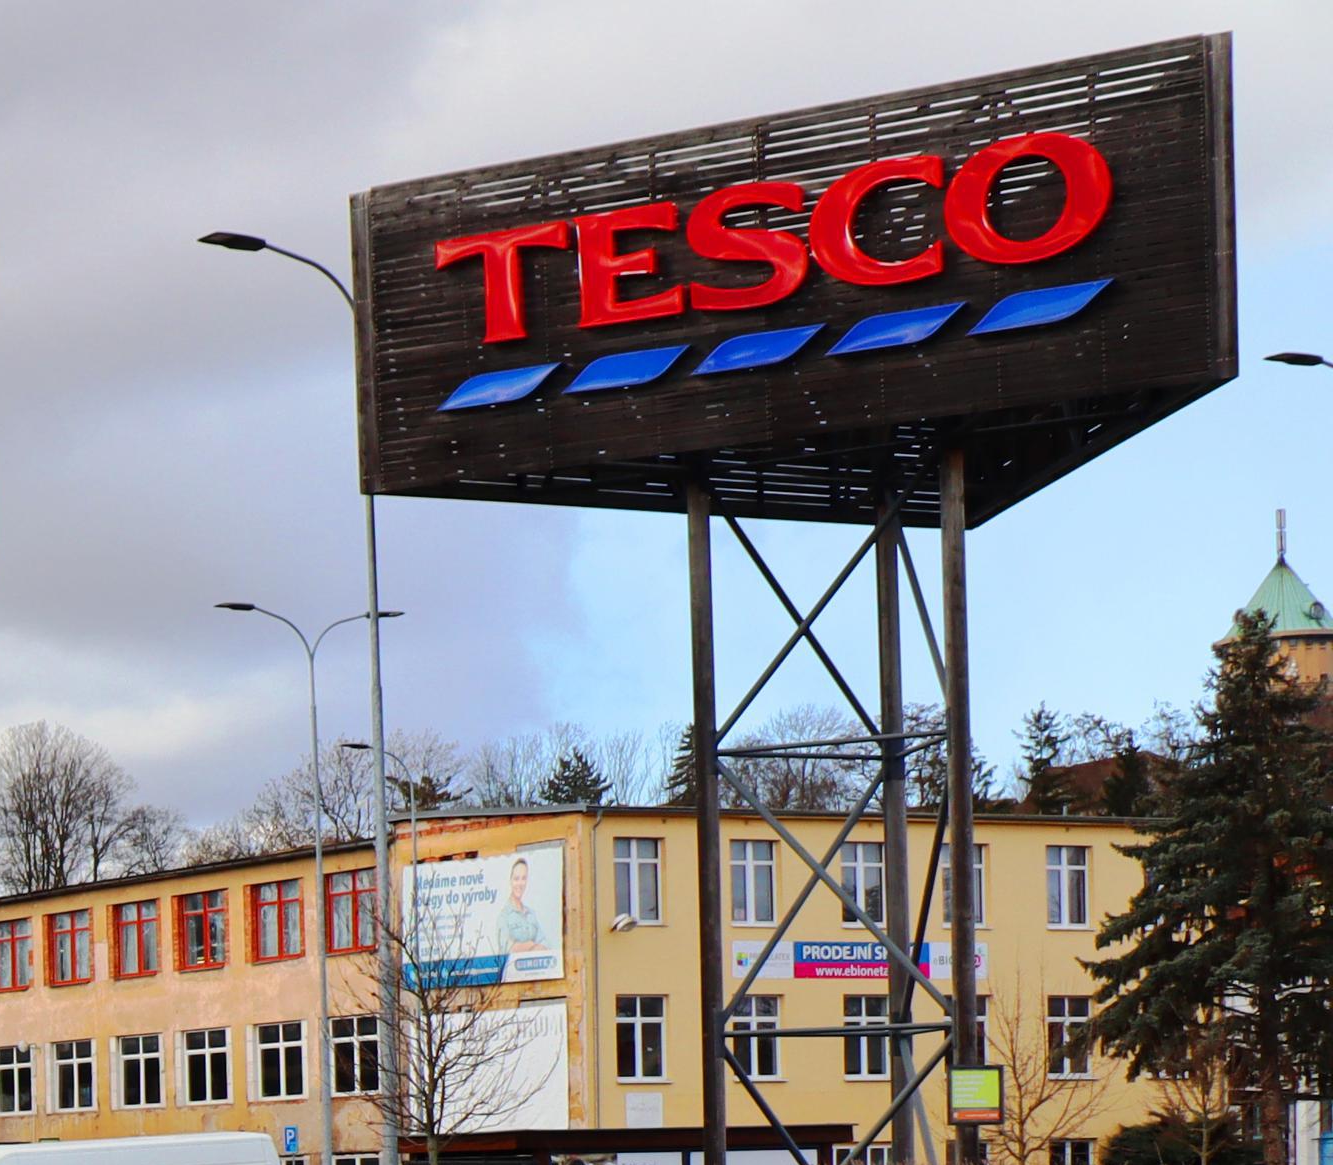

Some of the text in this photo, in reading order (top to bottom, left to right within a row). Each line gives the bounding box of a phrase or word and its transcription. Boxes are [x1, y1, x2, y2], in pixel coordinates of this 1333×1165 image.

[434, 131, 1114, 344] TESCO
[459, 869, 484, 886] nové
[446, 890, 459, 905] do
[462, 886, 498, 906] výroby
[802, 943, 872, 960] PRODEJNÍ
[286, 1129, 295, 1145] P
